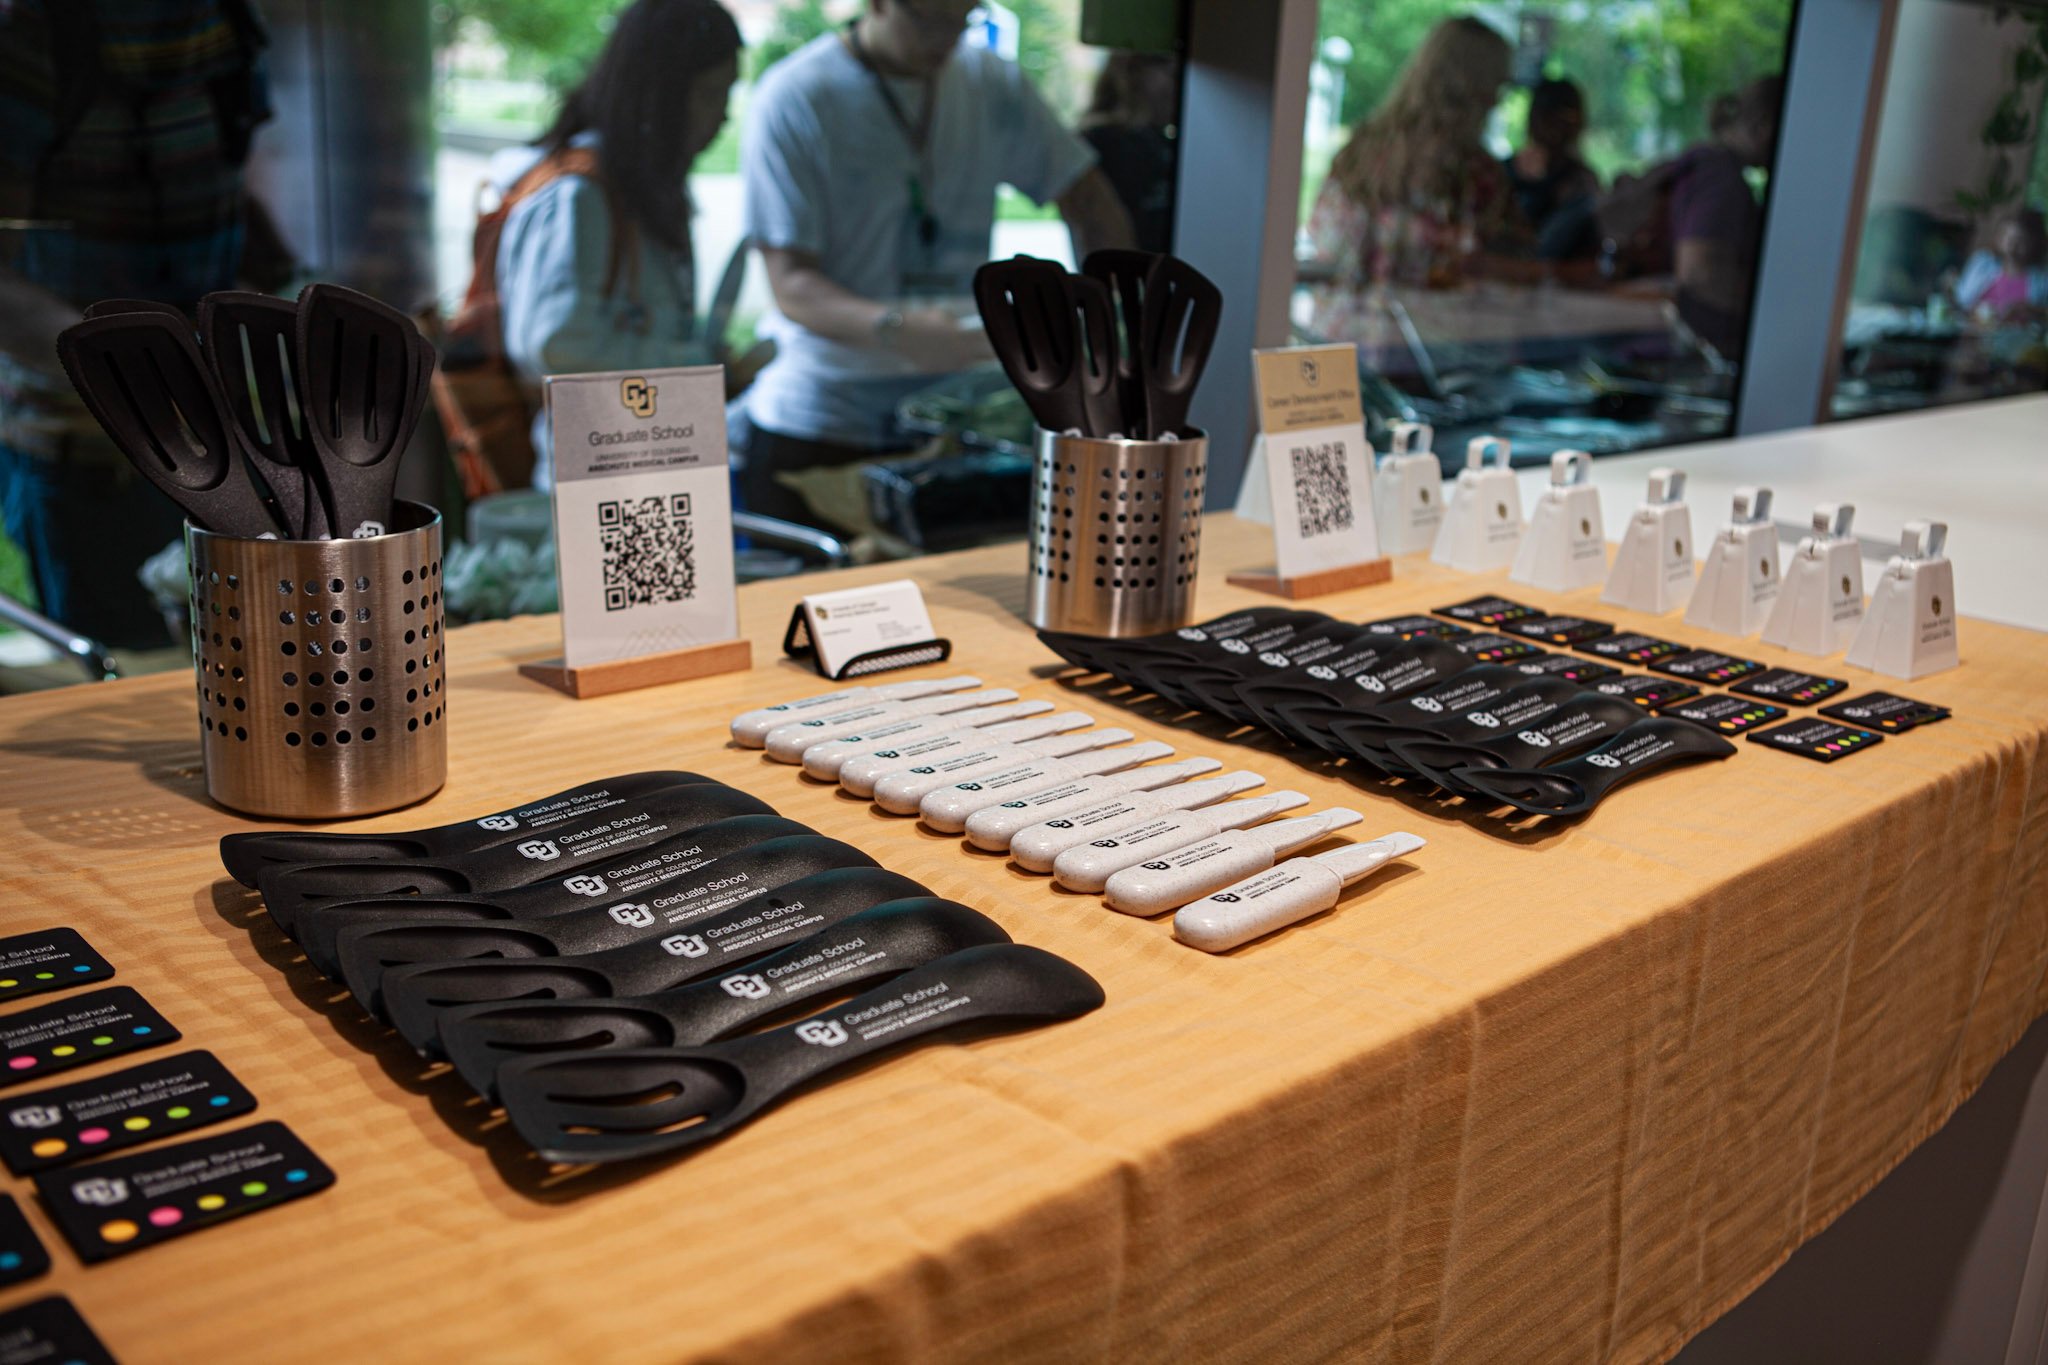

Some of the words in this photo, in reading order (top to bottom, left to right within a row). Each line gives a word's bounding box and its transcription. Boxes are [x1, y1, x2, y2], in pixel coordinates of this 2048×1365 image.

[588, 430, 649, 447] Graduate
[651, 424, 694, 441] School
[519, 800, 570, 818] Graduate
[570, 790, 610, 804] School
[531, 814, 568, 828] ANSCHUTZ
[568, 806, 598, 818] MEDICAL
[598, 798, 626, 809] CAMPUS
[559, 825, 611, 844] Graduate
[611, 812, 651, 829] School
[568, 837, 604, 852] UNIVERSITY
[605, 834, 614, 842] OF
[614, 823, 650, 838] COLORADO
[573, 842, 610, 857] ANSCHUTZ
[610, 833, 640, 847] MEDICAL
[639, 824, 668, 836] CAMPUS
[607, 857, 661, 880] Graduate
[661, 845, 703, 863] School
[616, 872, 655, 887] UNIVERSITY
[655, 868, 665, 876] OF
[665, 857, 701, 872] COLORADO
[621, 877, 660, 893] ANSCHUTZ
[660, 867, 692, 882] MEDICAL
[653, 886, 708, 909] Graduate
[707, 872, 749, 892] School
[662, 902, 702, 918] UNIVERSITY
[703, 897, 713, 906] OF
[713, 886, 749, 902] COLORADO
[668, 906, 707, 924] ANSCHUTZ
[706, 896, 739, 912] MEDICAL
[738, 887, 768, 901] CAMPUS
[706, 915, 763, 939] Graduate
[762, 901, 805, 921] School
[717, 931, 756, 948] UNIVERSITY
[756, 925, 767, 934] OF
[766, 914, 804, 931] COLORADO
[723, 936, 762, 953] ANSCHUTZ
[762, 925, 795, 941] MEDICAL
[794, 914, 825, 929] CAMPUS
[766, 954, 824, 979] Graduate
[822, 937, 866, 959] School
[856, 951, 886, 967] CAMPUS
[903, 981, 949, 1004] School
